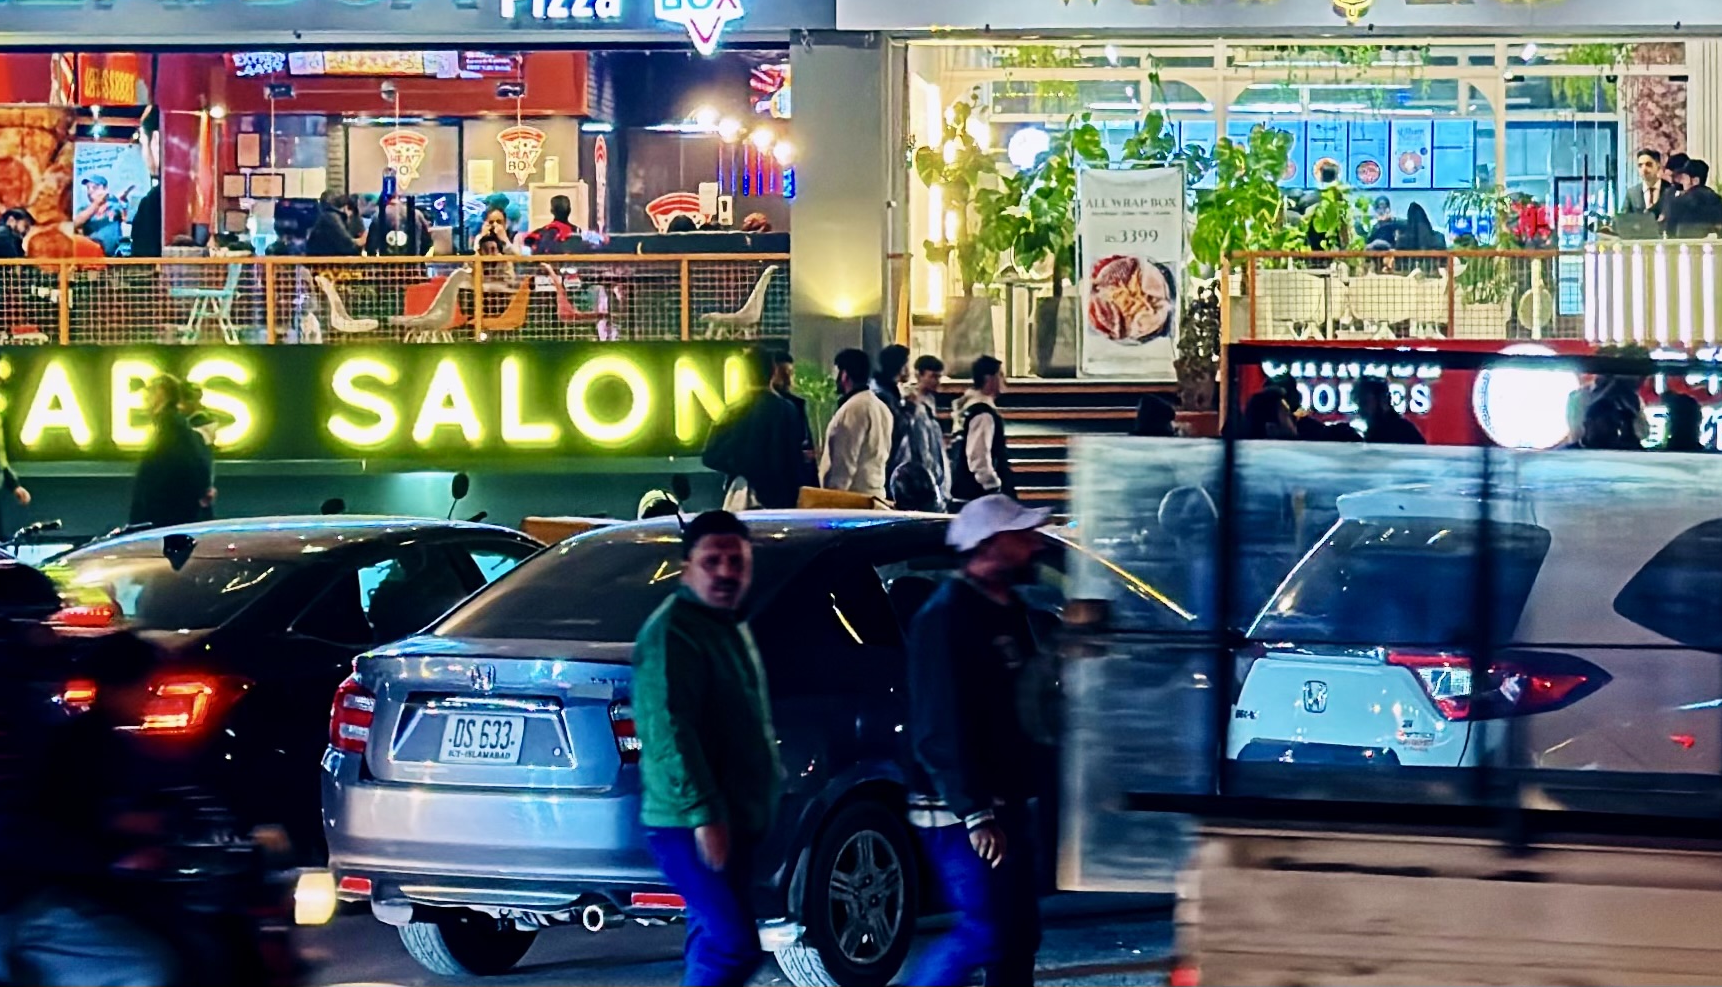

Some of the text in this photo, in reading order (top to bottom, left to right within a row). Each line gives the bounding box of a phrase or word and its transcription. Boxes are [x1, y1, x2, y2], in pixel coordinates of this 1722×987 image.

[1086, 197, 1177, 209] ALL WRAP BOX
[1119, 229, 1159, 243] 3399
[326, 354, 746, 450] SALON
[453, 718, 513, 750] DS 633
